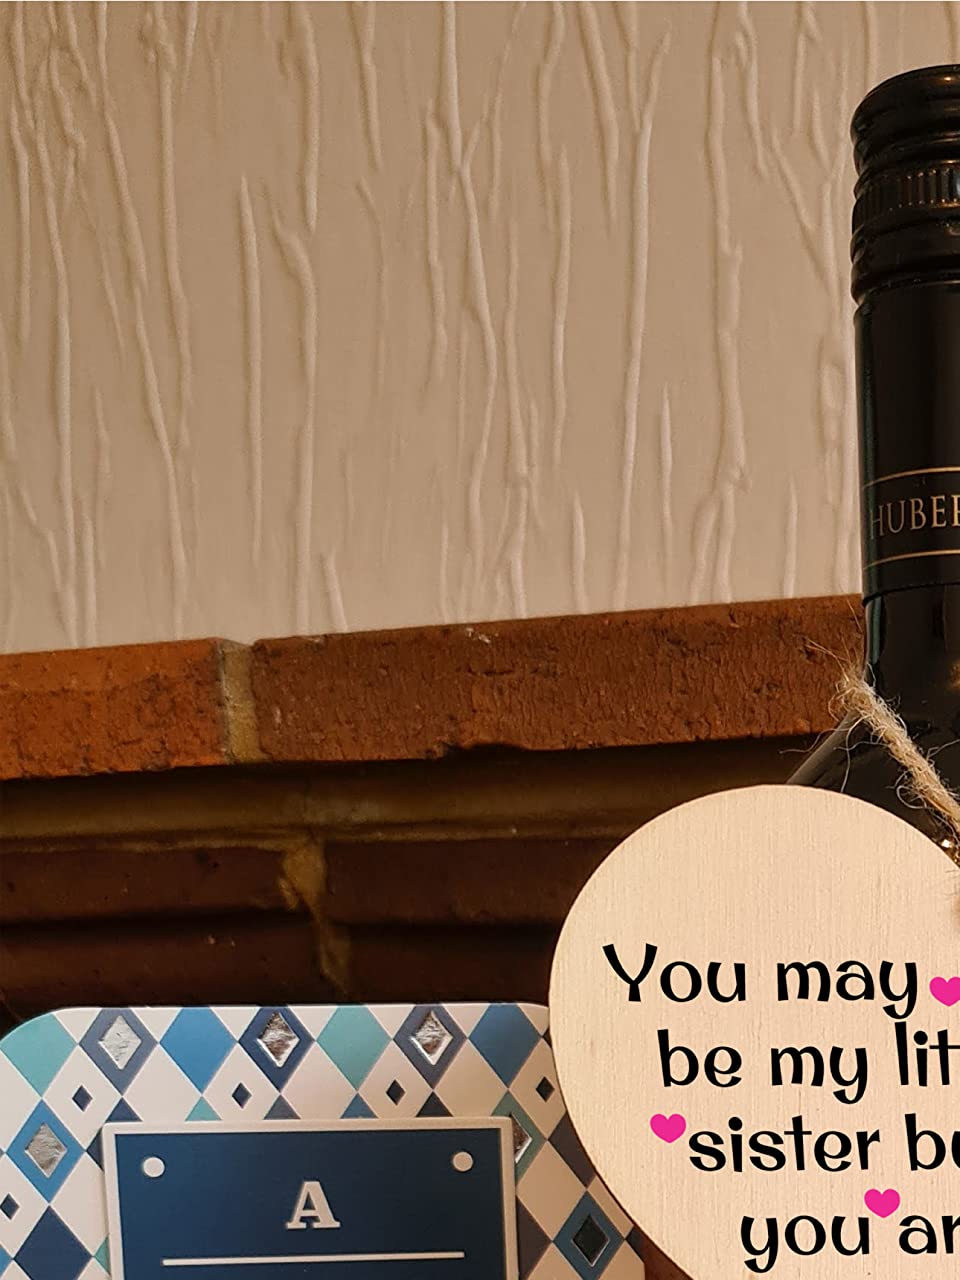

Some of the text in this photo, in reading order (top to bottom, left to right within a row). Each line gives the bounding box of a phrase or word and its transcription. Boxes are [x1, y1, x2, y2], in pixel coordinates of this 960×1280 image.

[603, 944, 918, 1019] You may
[658, 1029, 742, 1088] be
[771, 1045, 868, 1104] my
[689, 1116, 881, 1173] sister
[286, 1180, 341, 1229] A
[741, 1215, 870, 1272] you
